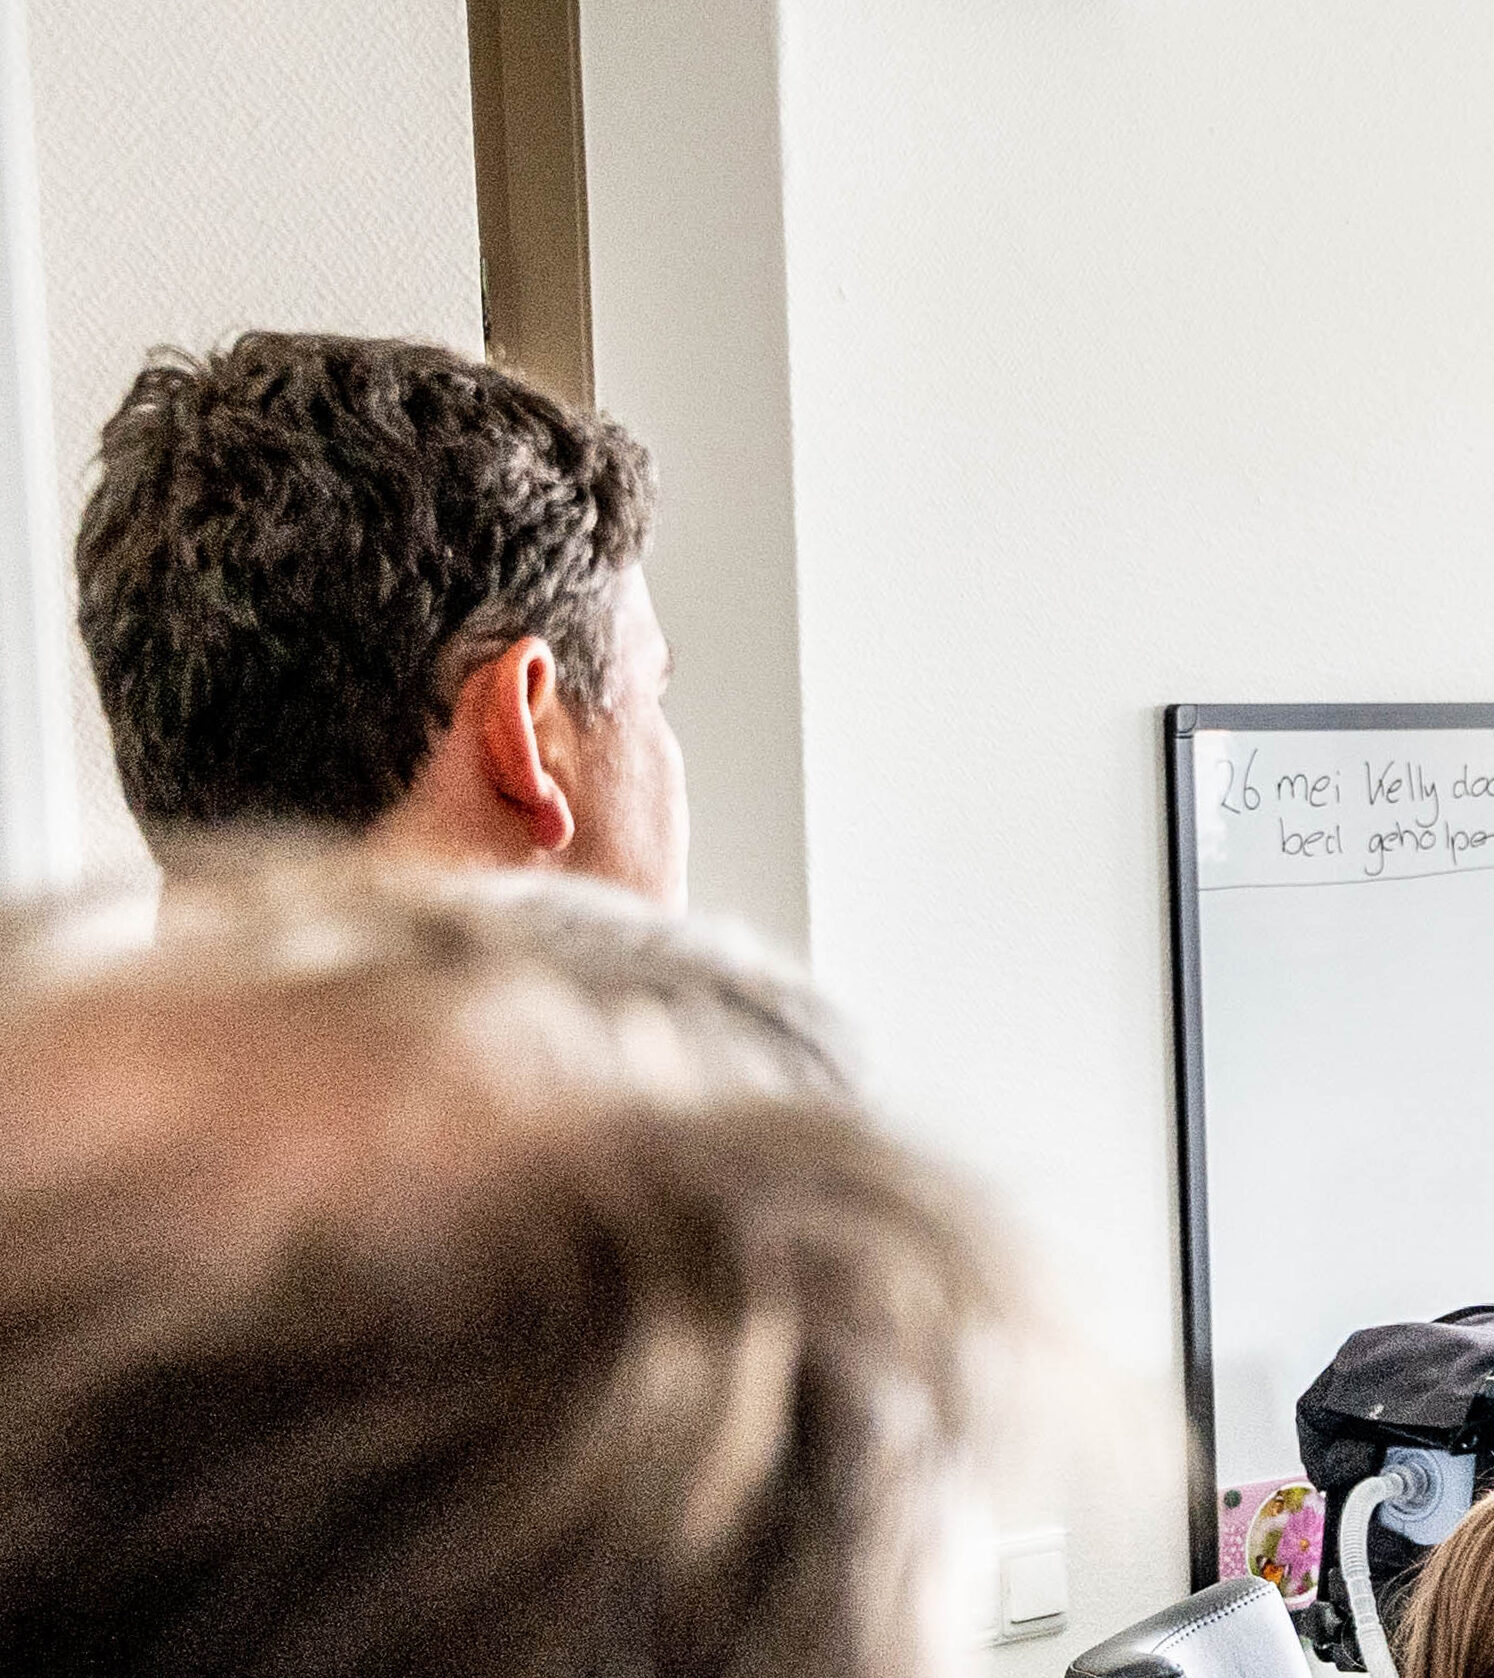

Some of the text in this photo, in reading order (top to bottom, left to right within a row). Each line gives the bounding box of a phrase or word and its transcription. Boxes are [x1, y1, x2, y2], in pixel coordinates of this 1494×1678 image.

[1217, 748, 1261, 814] 26
[1277, 769, 1341, 807] mei
[1365, 760, 1440, 829] Kelly
[1279, 817, 1342, 857] bed
